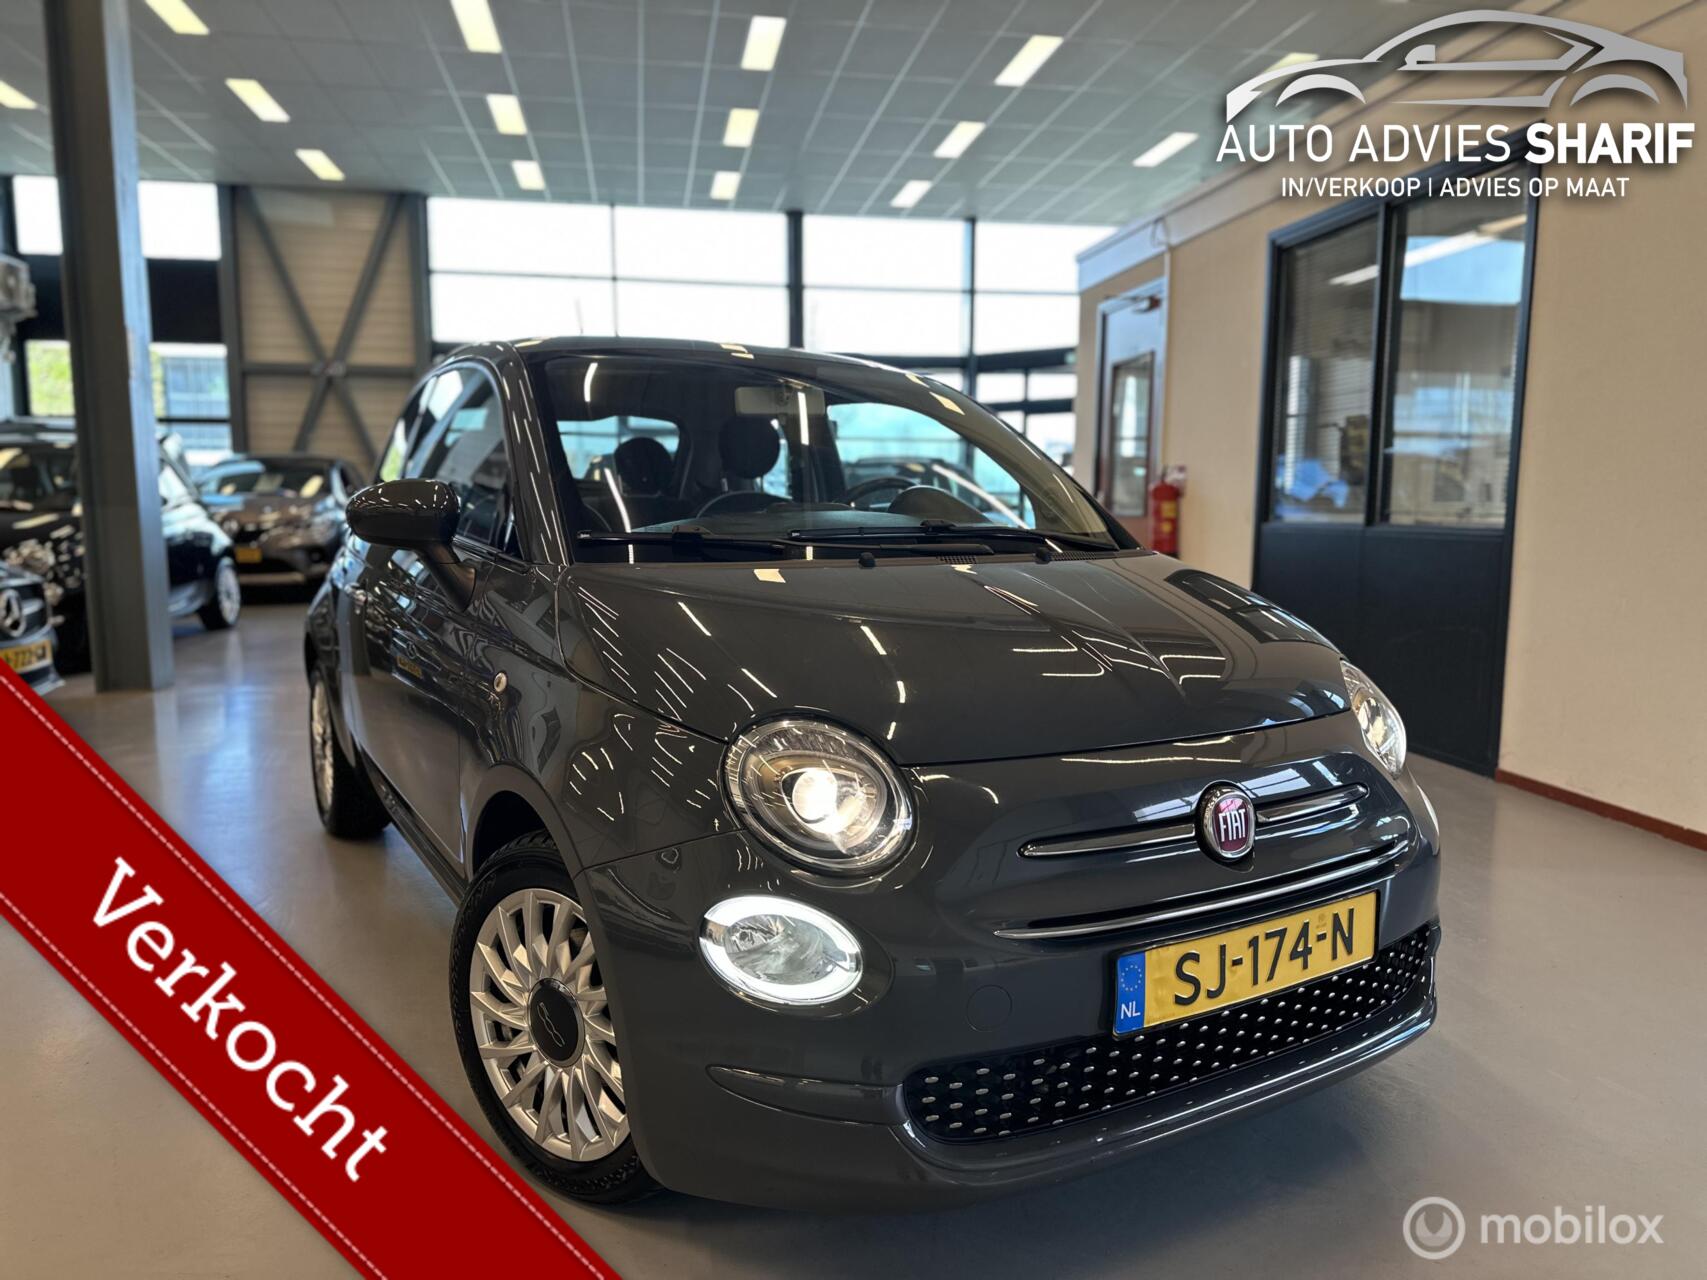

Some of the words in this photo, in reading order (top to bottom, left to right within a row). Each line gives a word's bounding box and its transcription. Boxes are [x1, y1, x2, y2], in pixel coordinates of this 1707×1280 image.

[1218, 807, 1246, 842] FIAT
[1174, 907, 1355, 1006] SJ-174-N
[1120, 1001, 1141, 1020] NL
